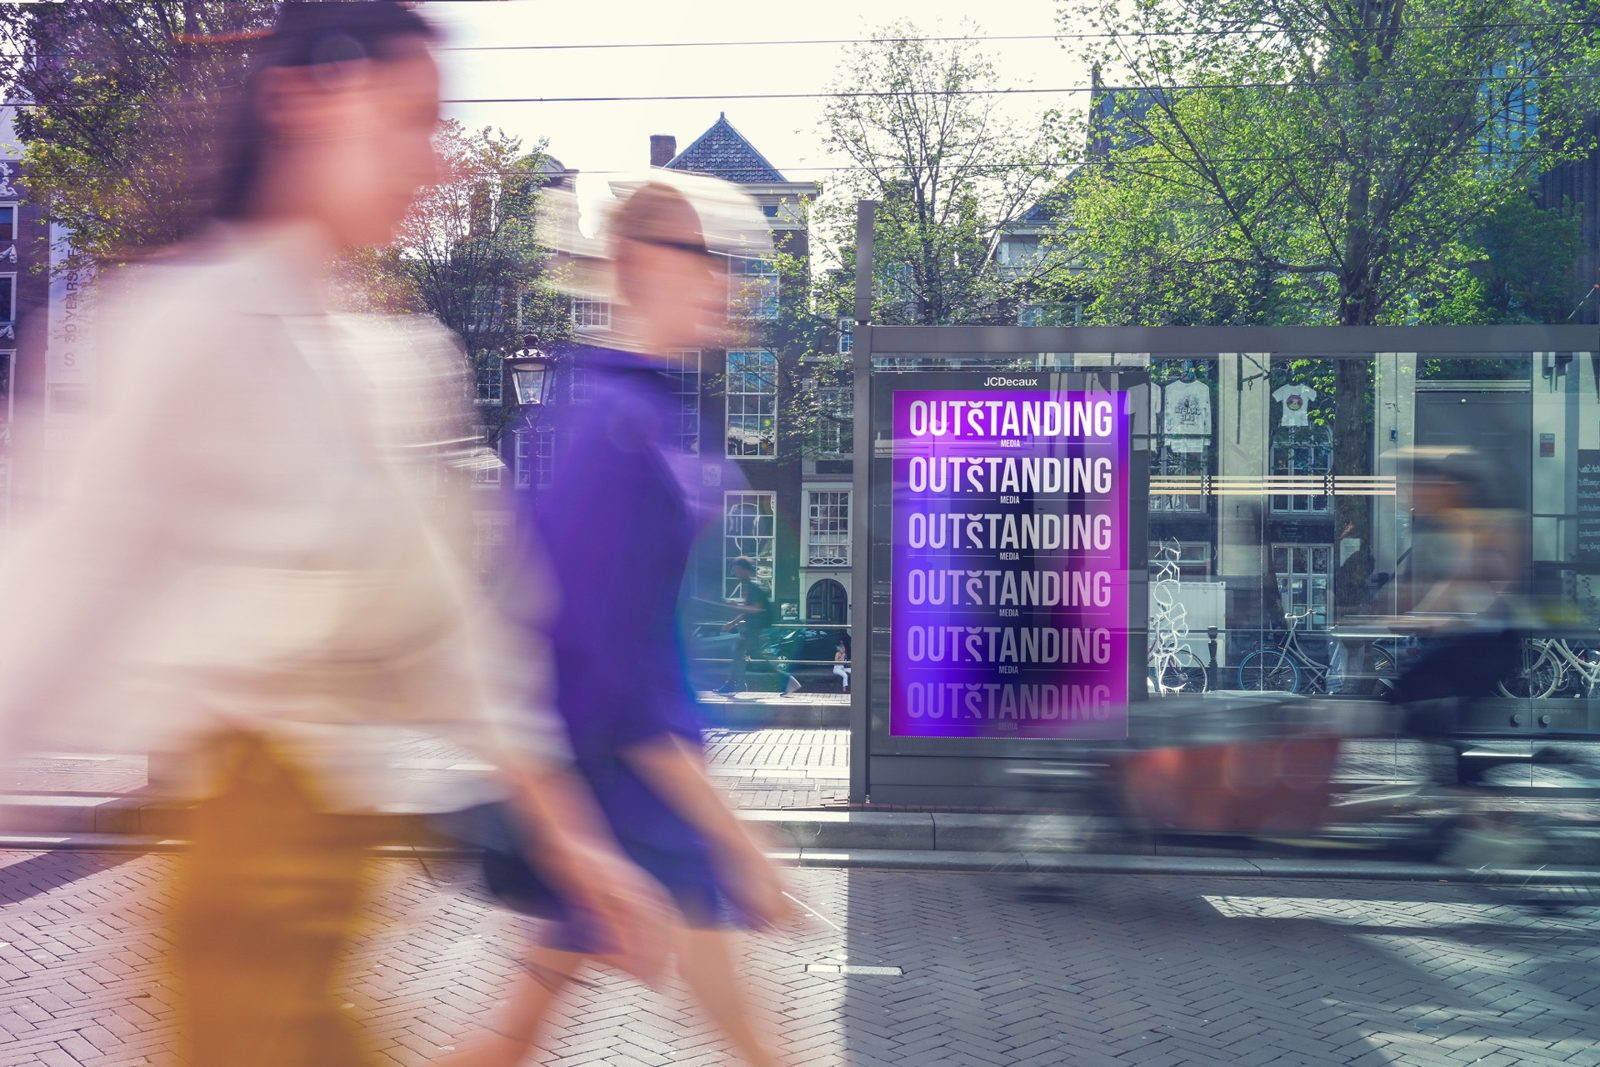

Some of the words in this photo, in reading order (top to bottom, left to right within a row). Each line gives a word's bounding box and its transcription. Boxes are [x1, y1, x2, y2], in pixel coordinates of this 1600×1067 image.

[983, 376, 1038, 387] JCDecaux
[909, 400, 1112, 437] OUTSTANDING
[1000, 439, 1020, 448] MEDIA
[909, 456, 1112, 494] OUTSTANDING
[1000, 496, 1020, 504] MEDIA
[908, 512, 1111, 550] OUTSTANDING
[999, 552, 1020, 561] MEDIA
[908, 568, 1111, 607] OUTSTANDING
[999, 608, 1019, 617] MEDIA
[907, 625, 1111, 664] OUTSTANDING
[998, 665, 1019, 674] MEDIA
[906, 682, 1110, 721] OUTSTANDING
